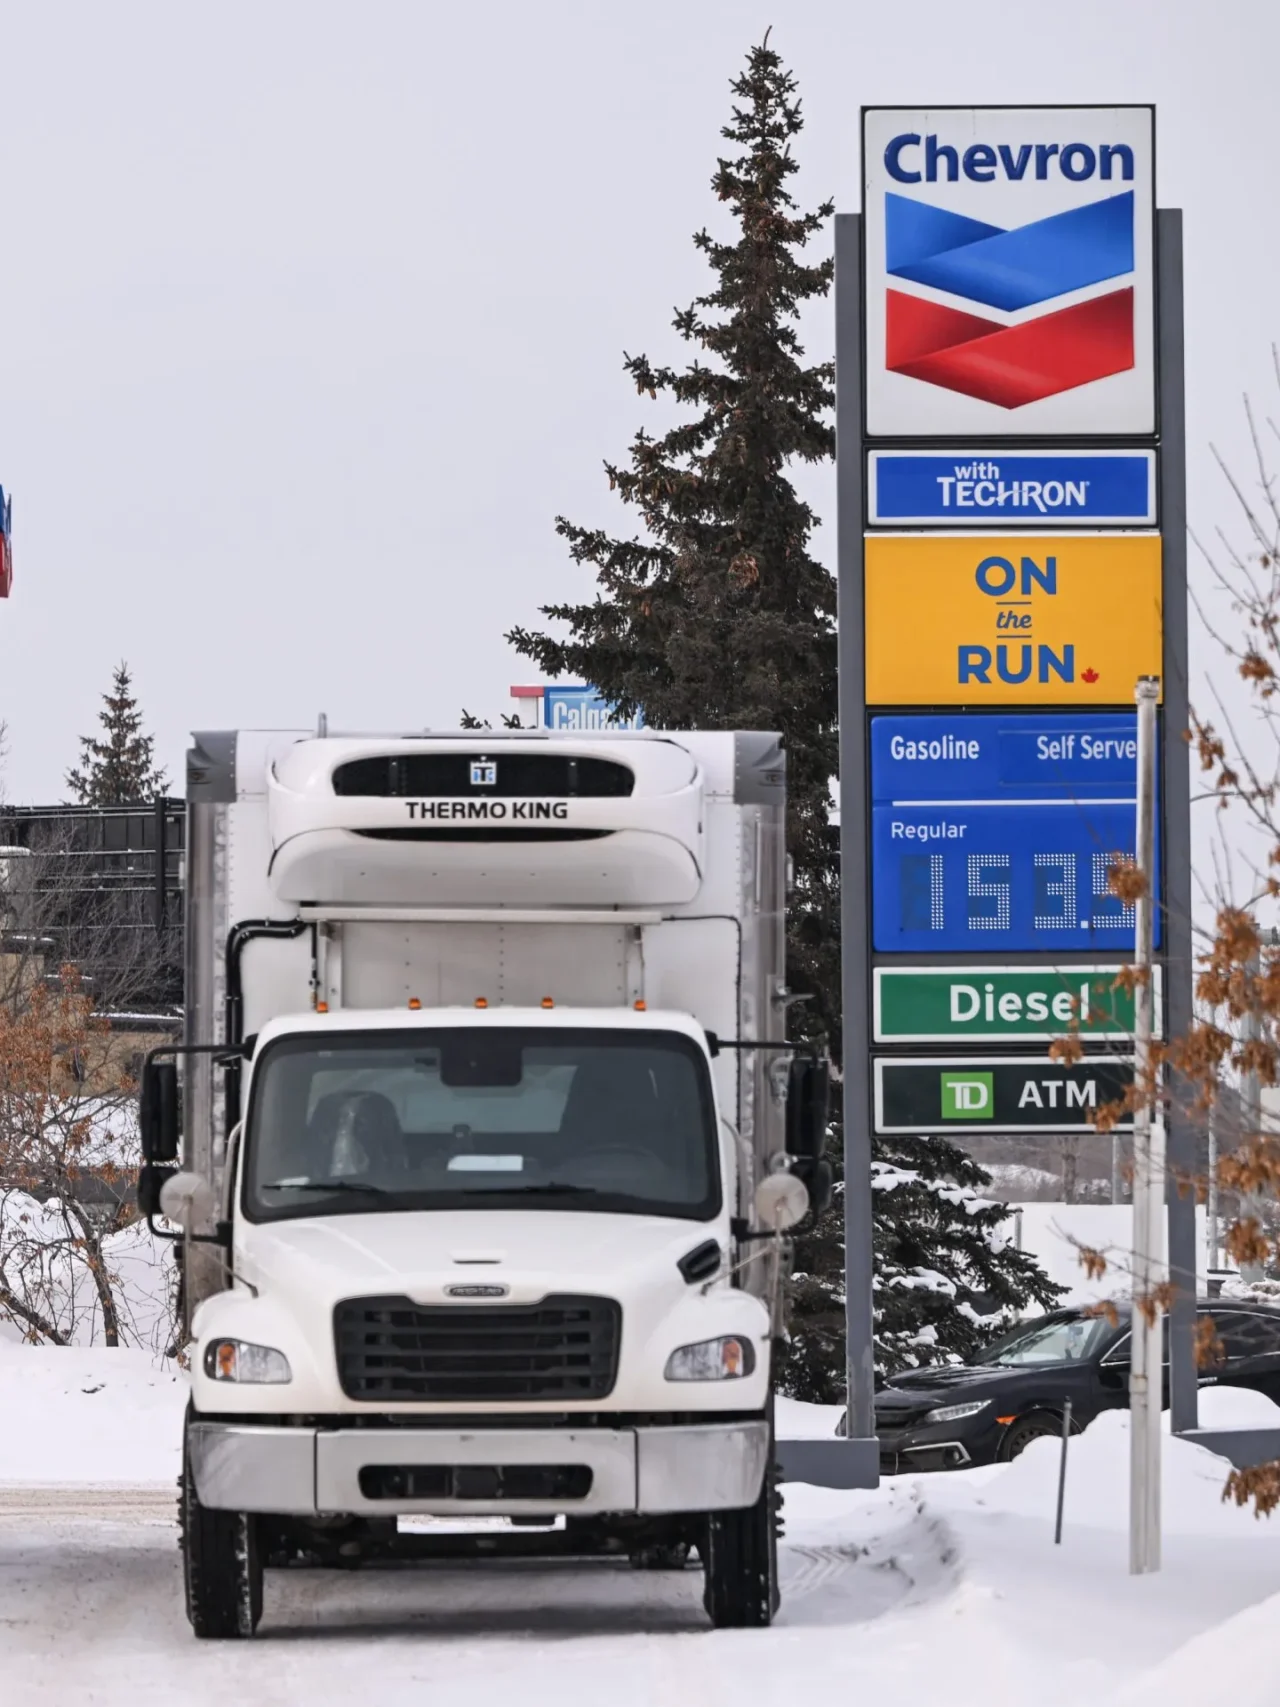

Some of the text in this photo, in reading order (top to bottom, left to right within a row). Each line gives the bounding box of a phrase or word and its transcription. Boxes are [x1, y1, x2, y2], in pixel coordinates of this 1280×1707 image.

[883, 133, 1135, 183] Chevron
[954, 462, 1000, 480] with
[975, 556, 1057, 596] ON
[996, 610, 1033, 629] the
[957, 645, 1075, 684] RUN
[890, 735, 1137, 760] Gasoline Self Serve
[405, 801, 569, 820] THERMO KING
[891, 821, 967, 842] Regular
[950, 982, 1089, 1022] Diesel
[946, 1079, 1097, 1110] TD ATM
